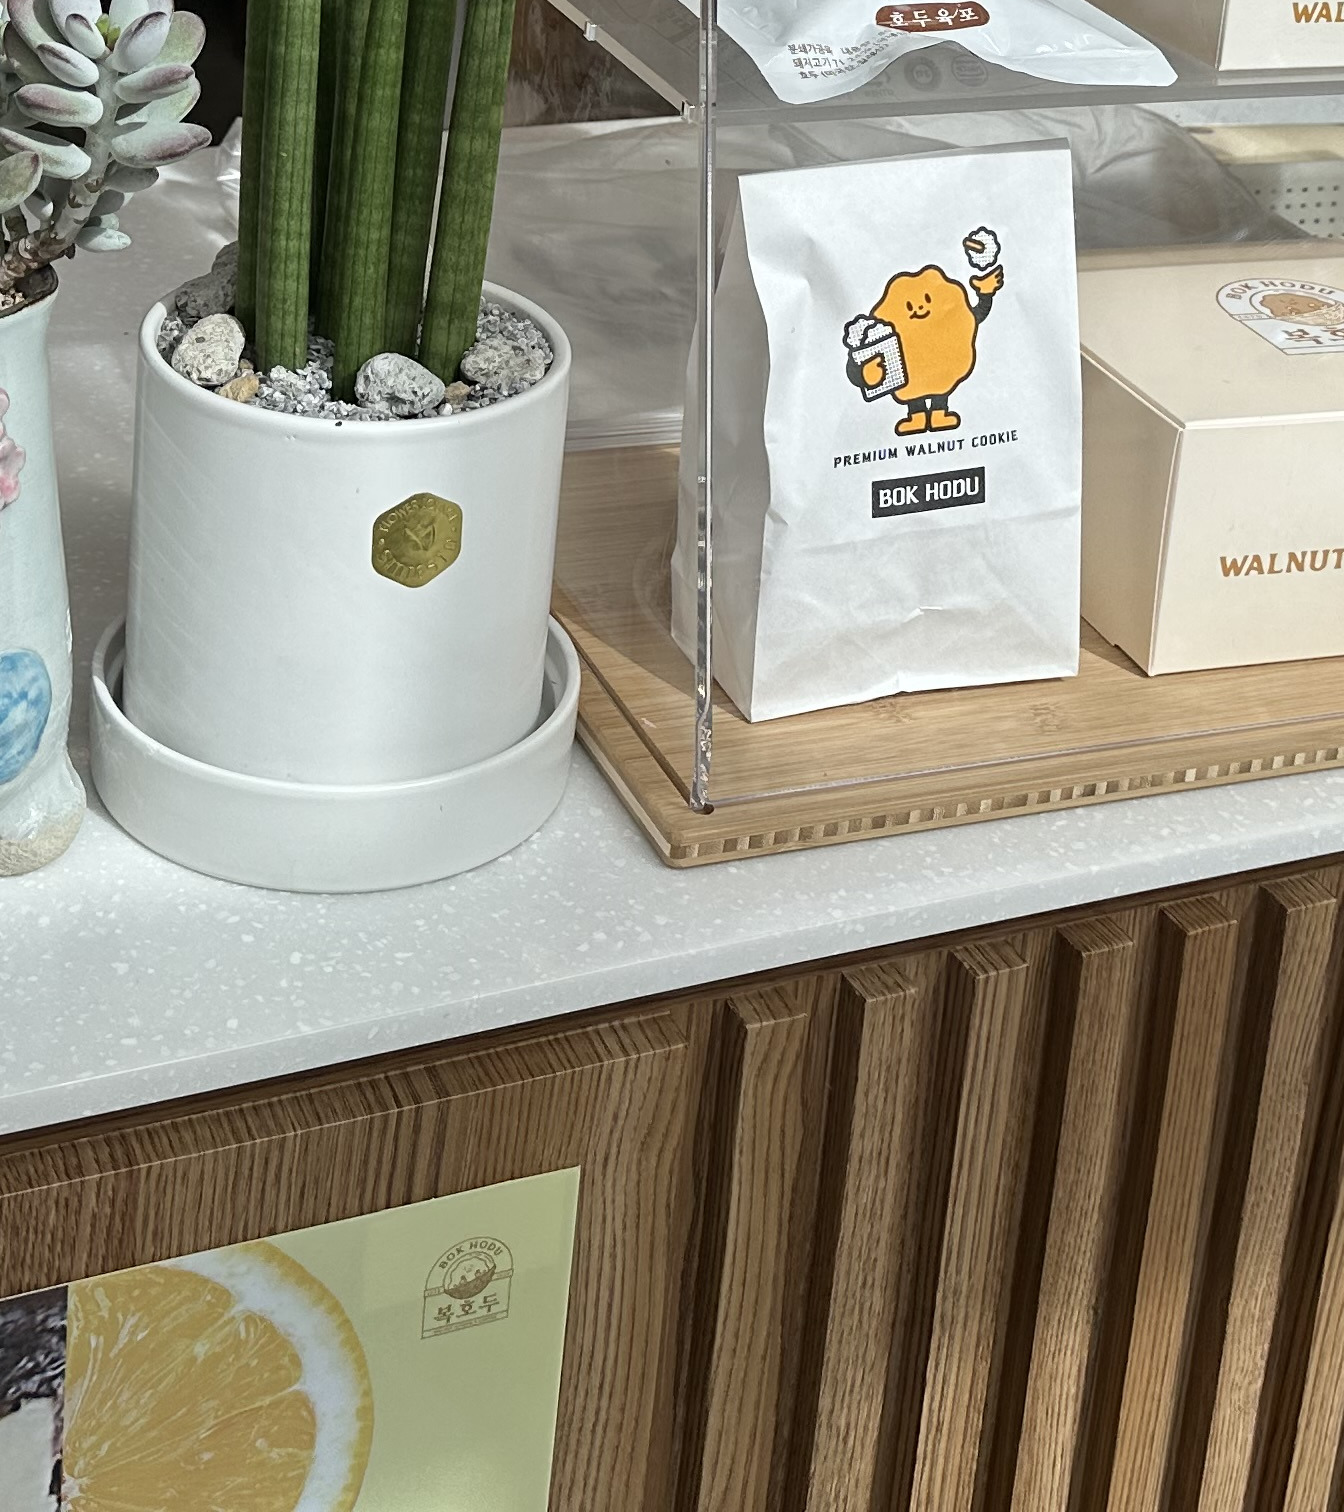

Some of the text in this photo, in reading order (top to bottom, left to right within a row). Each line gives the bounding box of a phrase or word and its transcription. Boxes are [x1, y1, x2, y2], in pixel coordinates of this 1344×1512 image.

[889, 7, 979, 28] 호두육포
[1226, 280, 1336, 300] BOK HODU
[834, 429, 1019, 469] PREMIUM WALNUT COOKIE
[878, 476, 980, 508] BOK HODU
[438, 1240, 504, 1269] BOK HODU
[434, 1292, 500, 1324] 복호두
